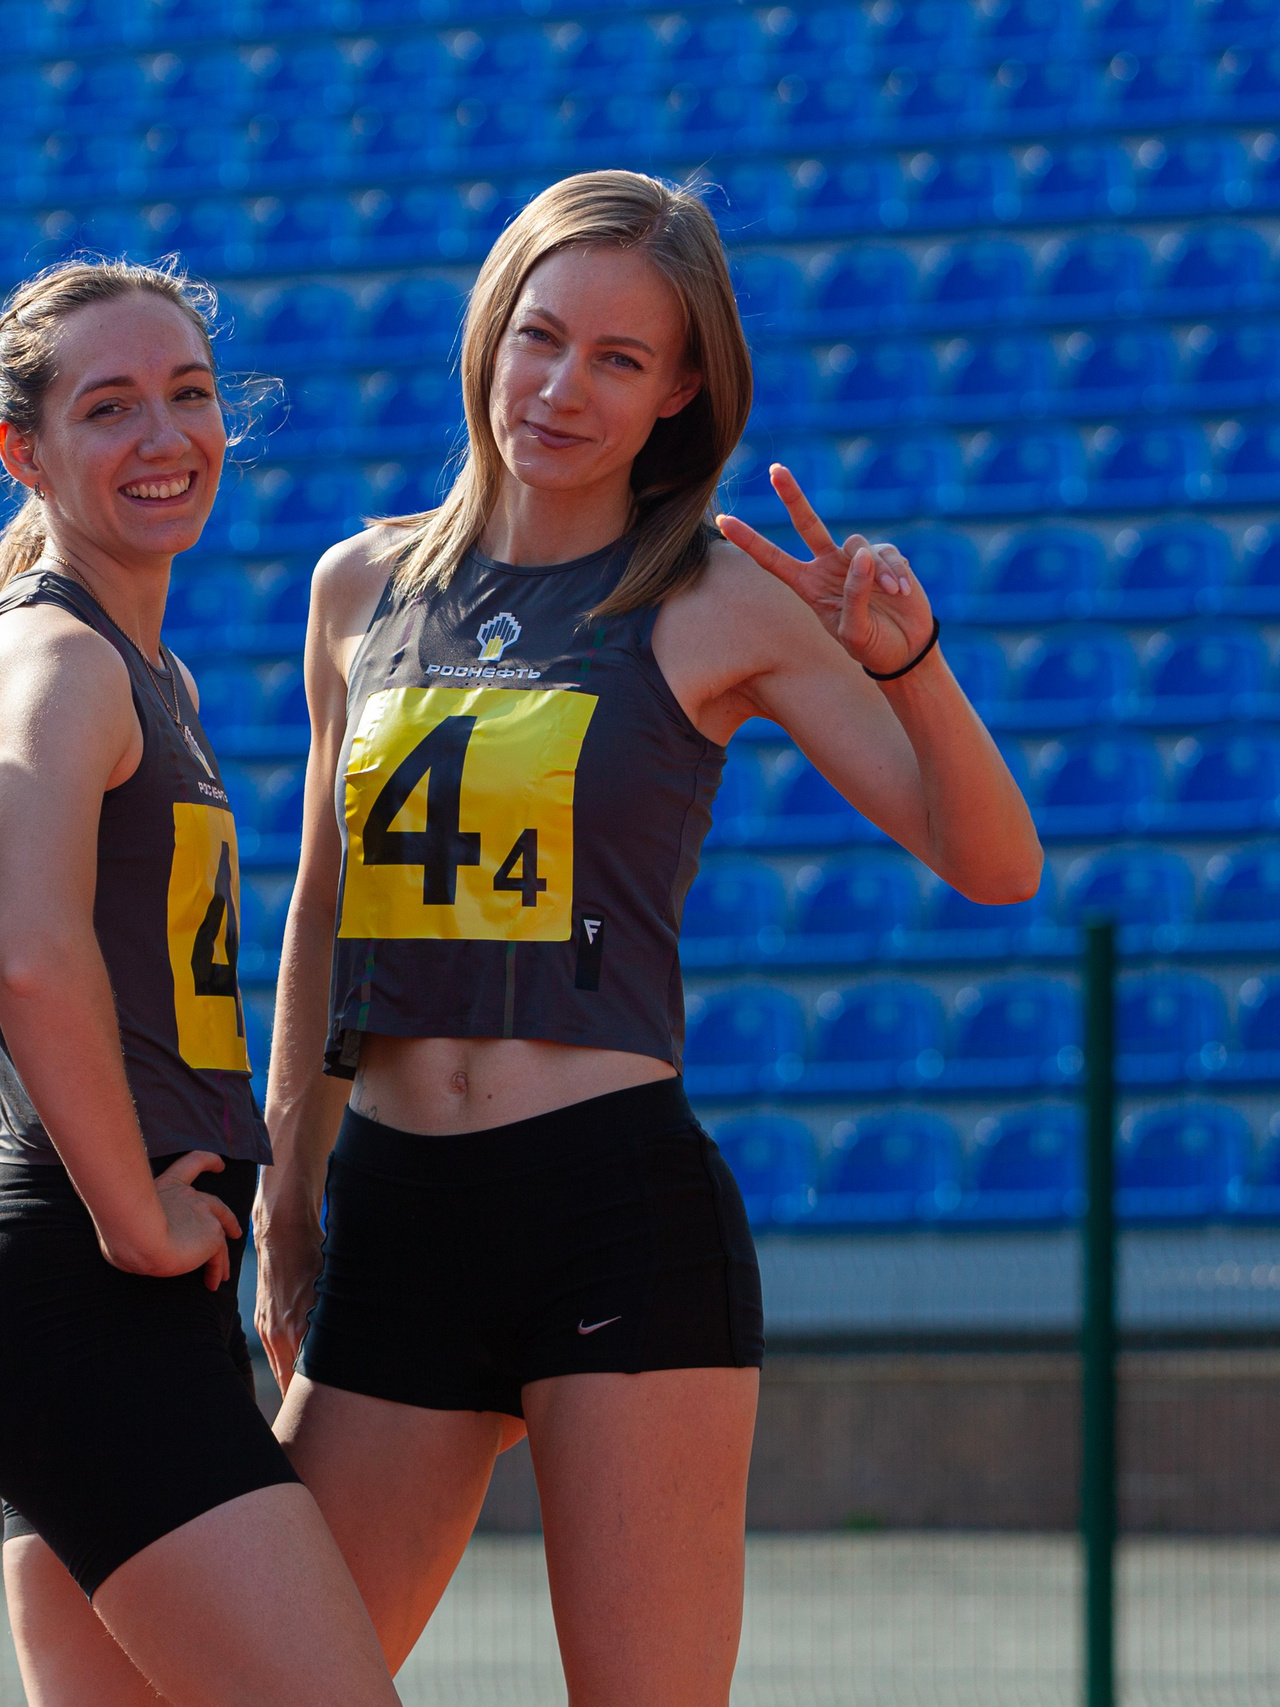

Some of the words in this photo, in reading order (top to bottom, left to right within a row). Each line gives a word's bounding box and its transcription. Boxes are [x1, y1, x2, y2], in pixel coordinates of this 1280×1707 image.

[425, 664, 541, 679] РОСНЕФТЬ
[363, 715, 481, 905] 4
[493, 828, 547, 907] 4
[191, 840, 245, 1038] 4
